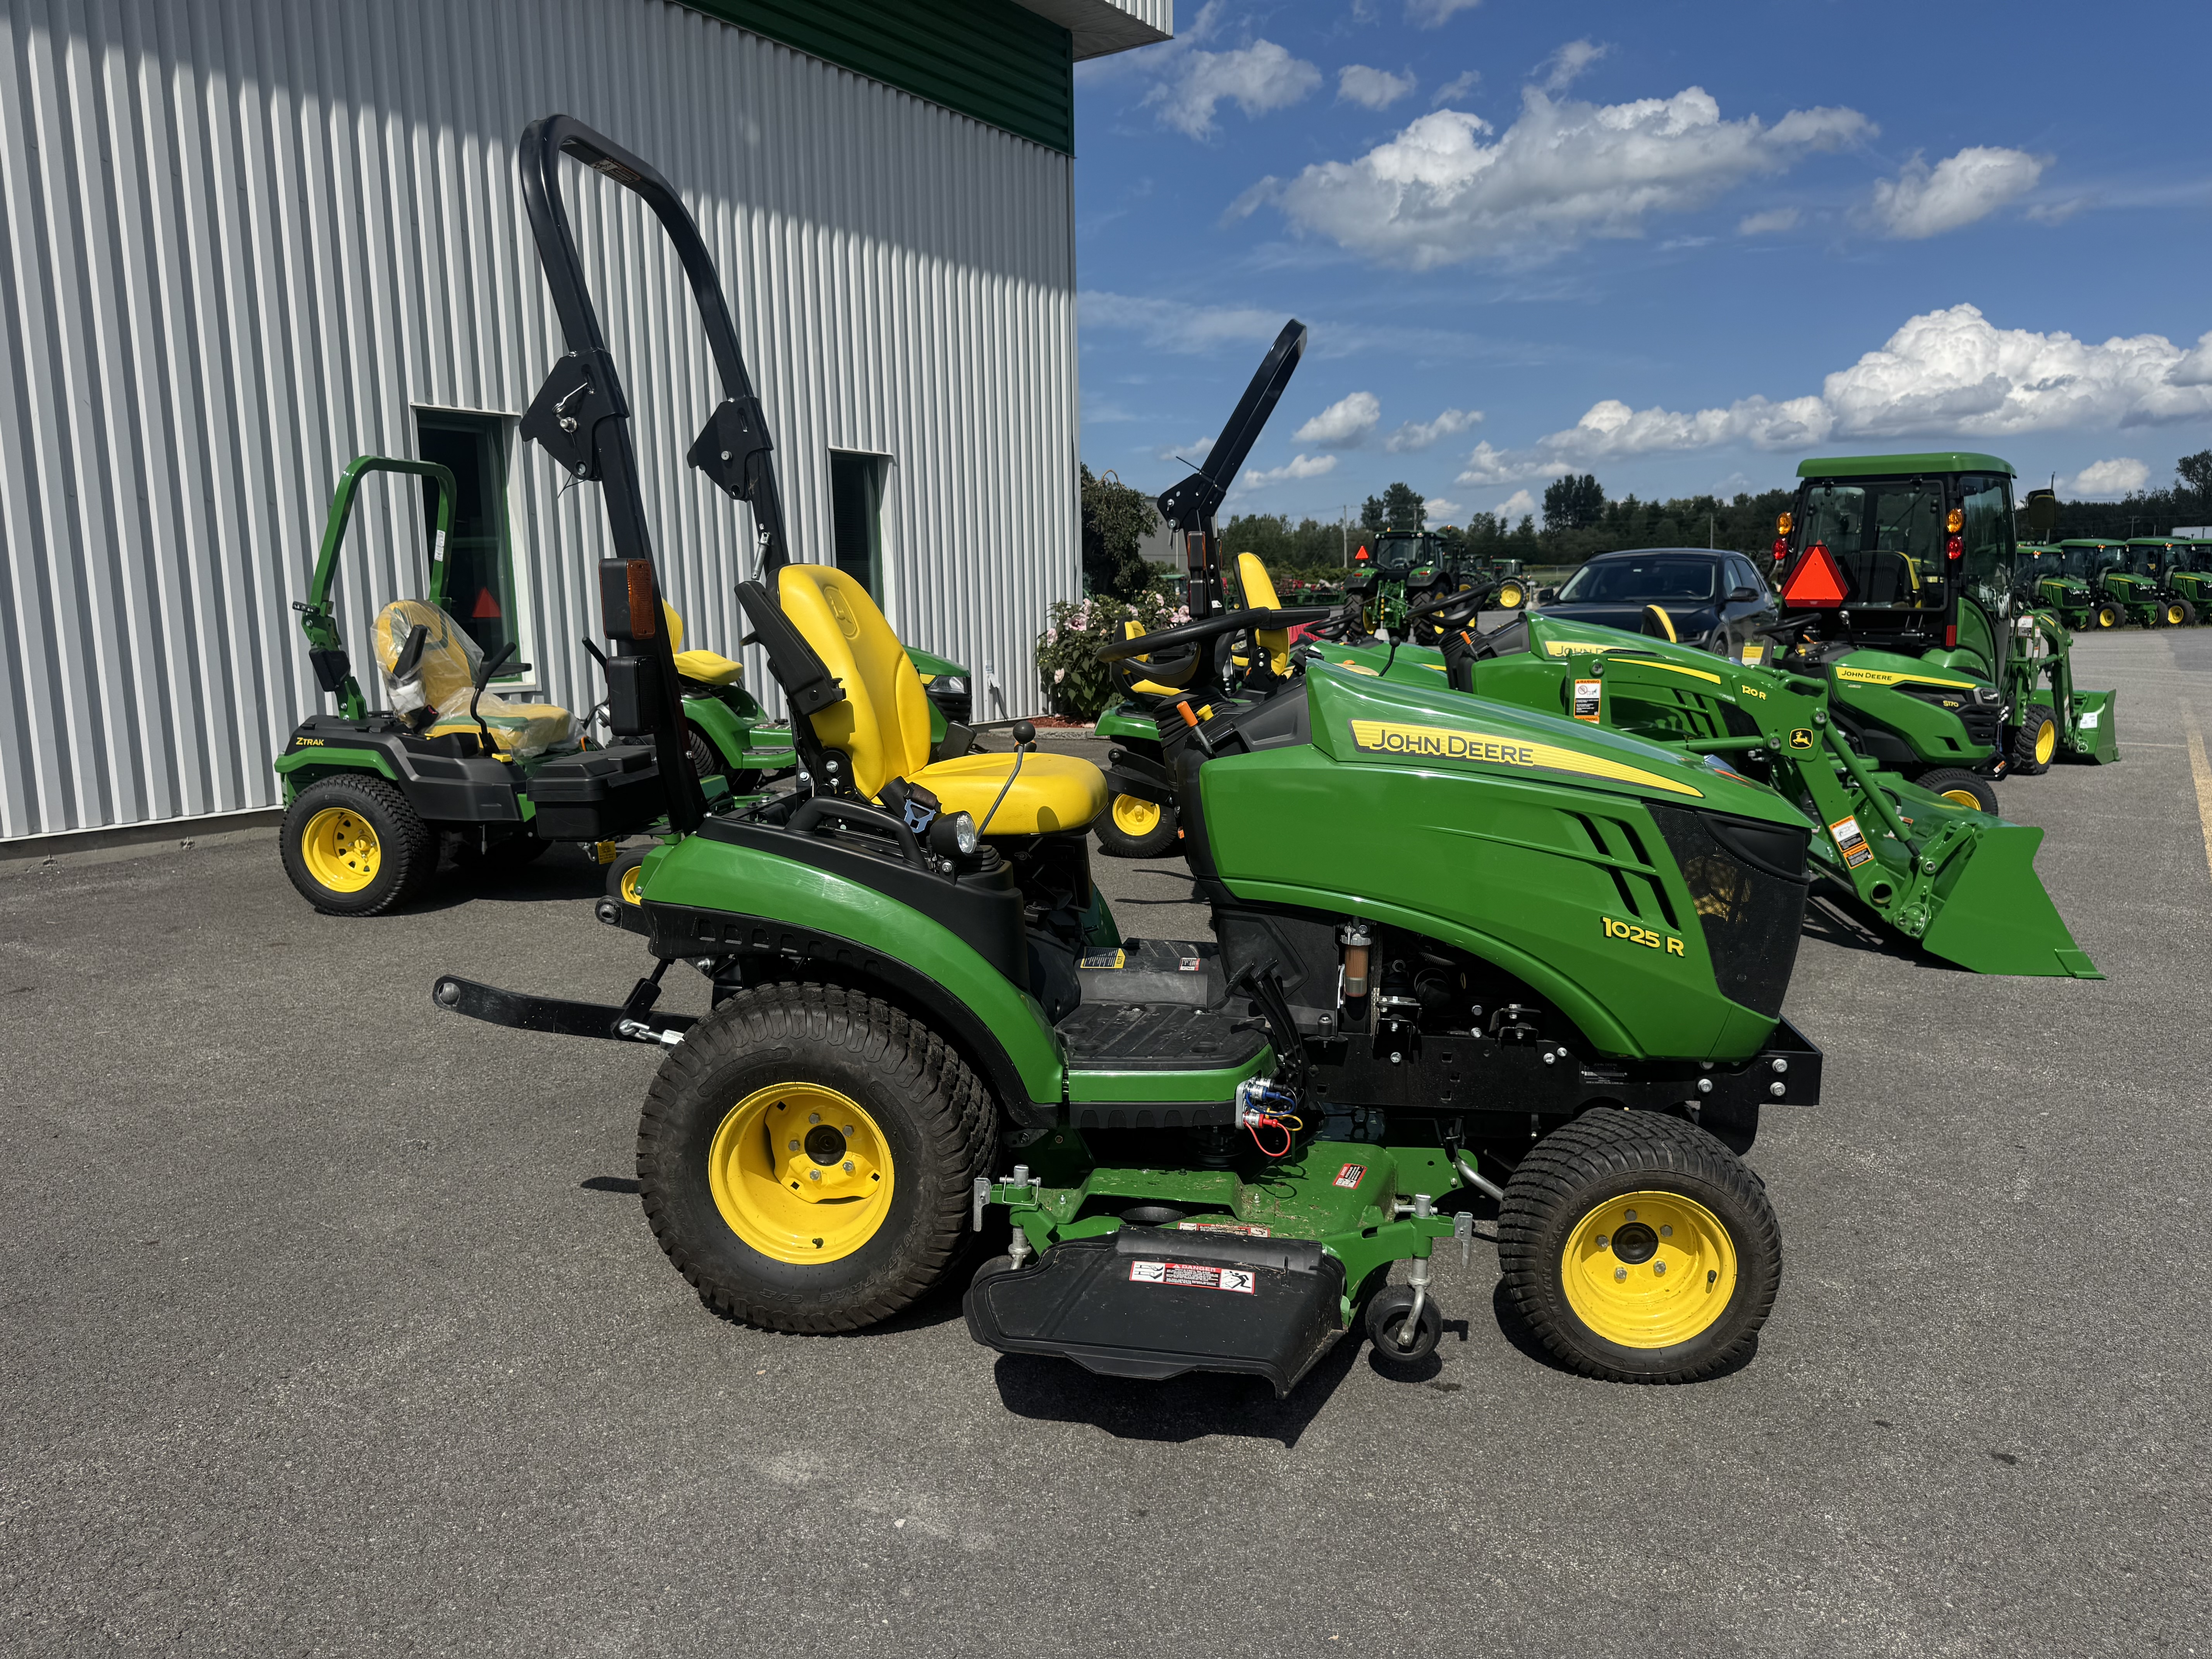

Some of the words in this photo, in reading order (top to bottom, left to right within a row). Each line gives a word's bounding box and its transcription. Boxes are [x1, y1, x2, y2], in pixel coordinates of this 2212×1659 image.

[1865, 672, 1892, 681] DEERE
[1741, 685, 1758, 697] 120
[1759, 691, 1766, 700] R
[295, 737, 325, 746] ZTRAK
[1372, 729, 1441, 754] JOHN
[1448, 735, 1534, 764] DEERE
[1602, 916, 1661, 948] 1025
[1666, 936, 1685, 957] R
[705, 1049, 784, 1091] CARLISLE
[881, 1215, 921, 1276] MULTI
[1181, 1264, 1217, 1273] DANGER
[818, 1275, 875, 1303] TRAC
